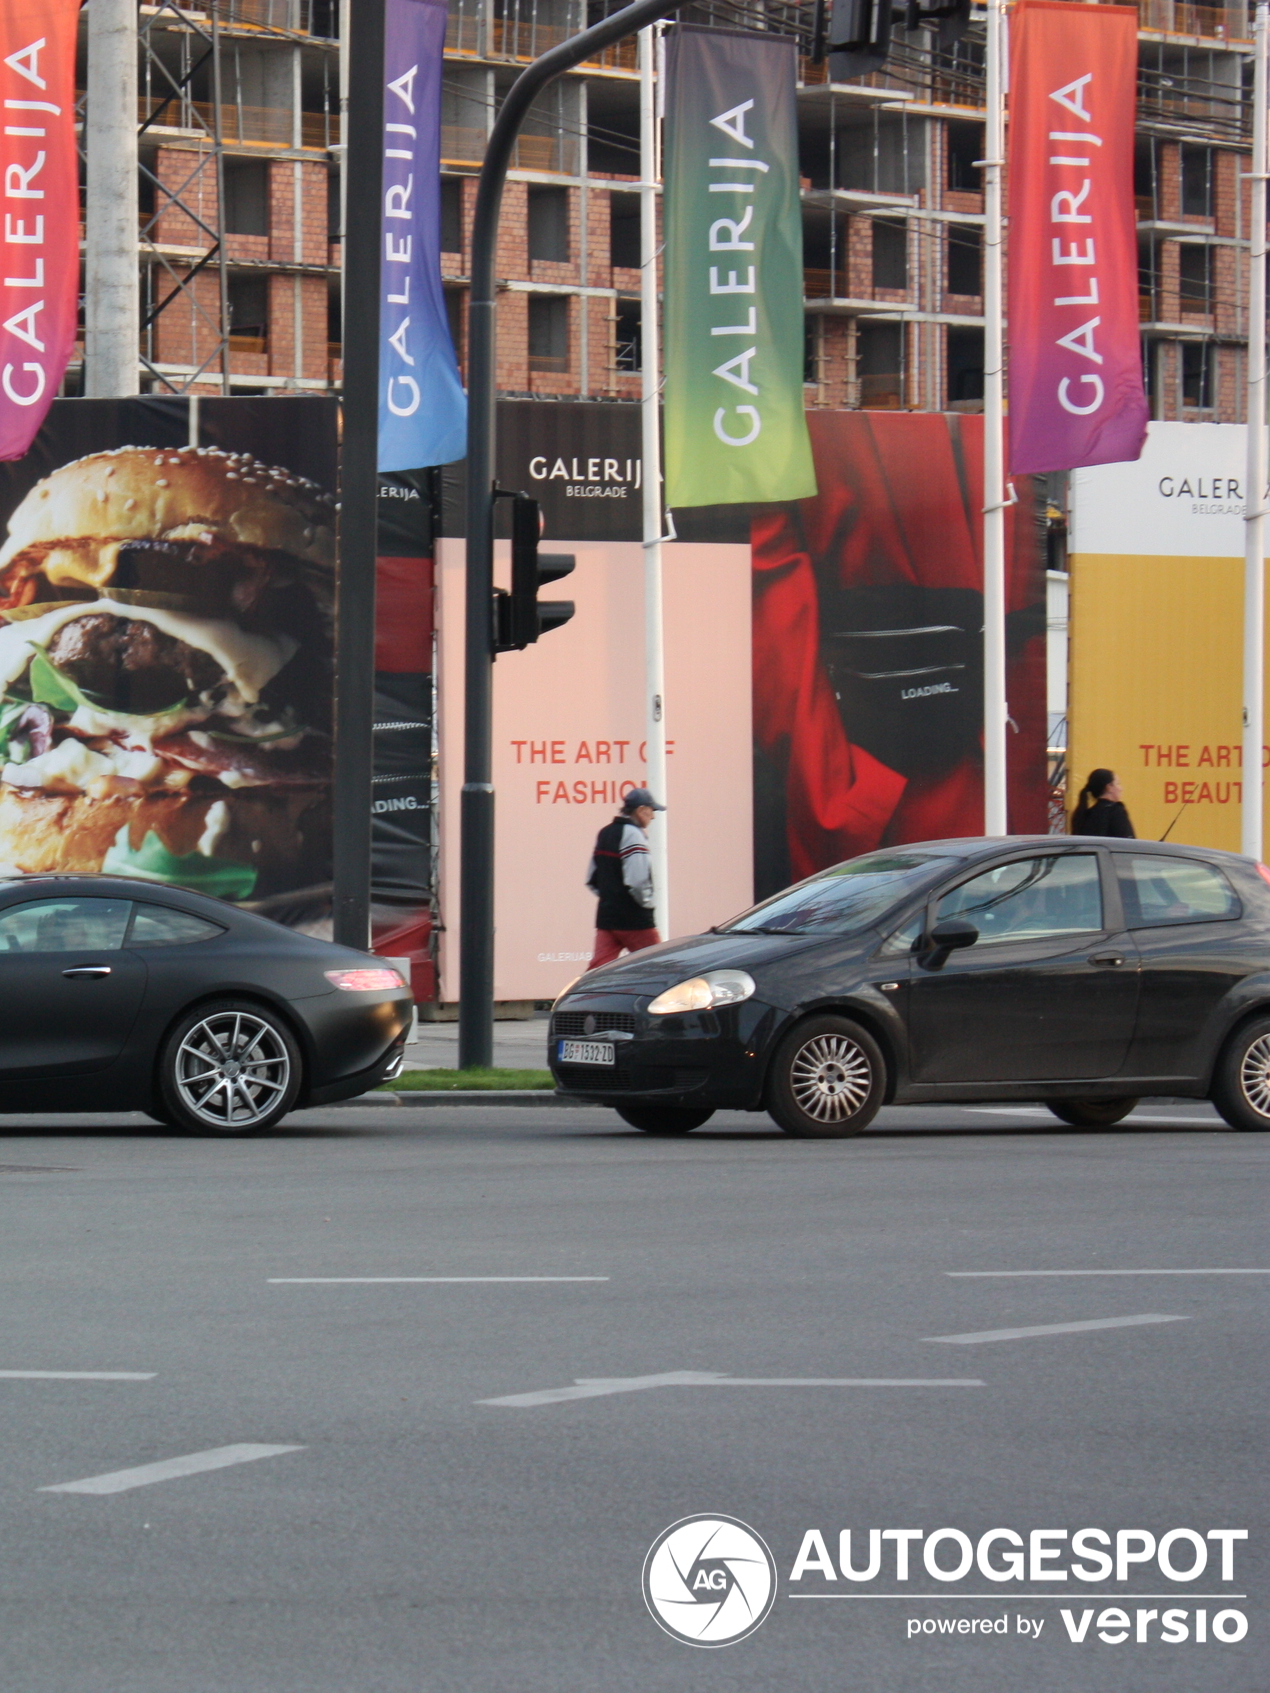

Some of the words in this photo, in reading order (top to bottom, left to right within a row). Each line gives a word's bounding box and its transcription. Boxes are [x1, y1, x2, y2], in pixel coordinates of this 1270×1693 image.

[2, 37, 61, 406] GALERIJA
[386, 65, 420, 417] GALERIJA
[1048, 72, 1104, 416] GALERIJA
[708, 98, 769, 448] GALERIJA
[529, 456, 664, 489] GALERIJ
[376, 486, 420, 501] ERIJA
[566, 485, 628, 498] BELGRADE
[510, 740, 566, 764] THE
[574, 740, 630, 764] ART
[1139, 744, 1190, 767] THE
[1196, 745, 1243, 767] ART
[536, 780, 647, 804] FASHIO
[1164, 781, 1264, 803] BEAUT
[563, 1042, 575, 1059] BG
